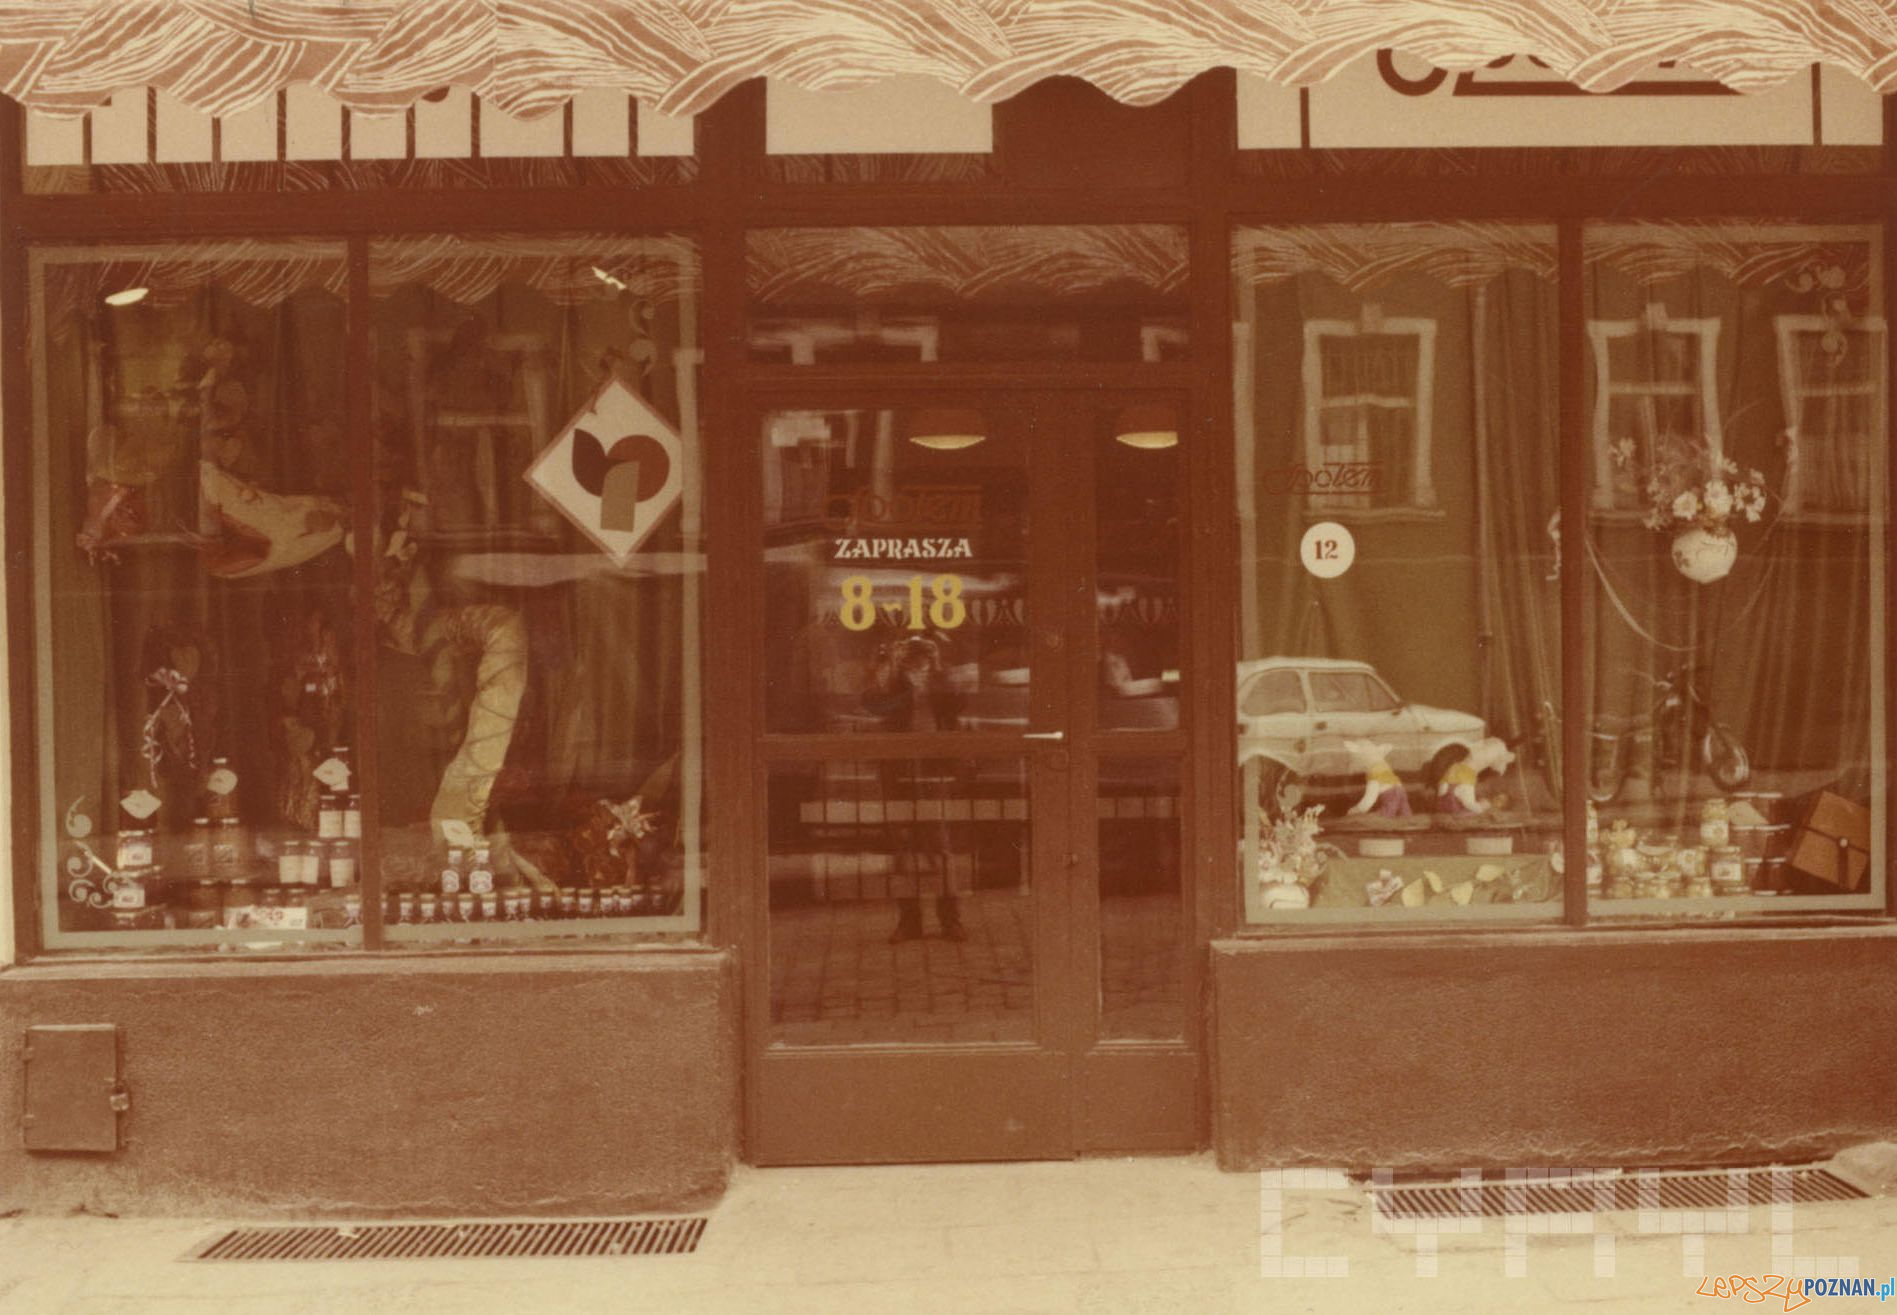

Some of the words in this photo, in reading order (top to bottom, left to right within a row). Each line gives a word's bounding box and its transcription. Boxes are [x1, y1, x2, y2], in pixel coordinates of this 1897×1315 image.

[834, 538, 974, 560] ZAPRASZA
[1315, 540, 1338, 560] 12
[839, 573, 967, 631] 8-18
